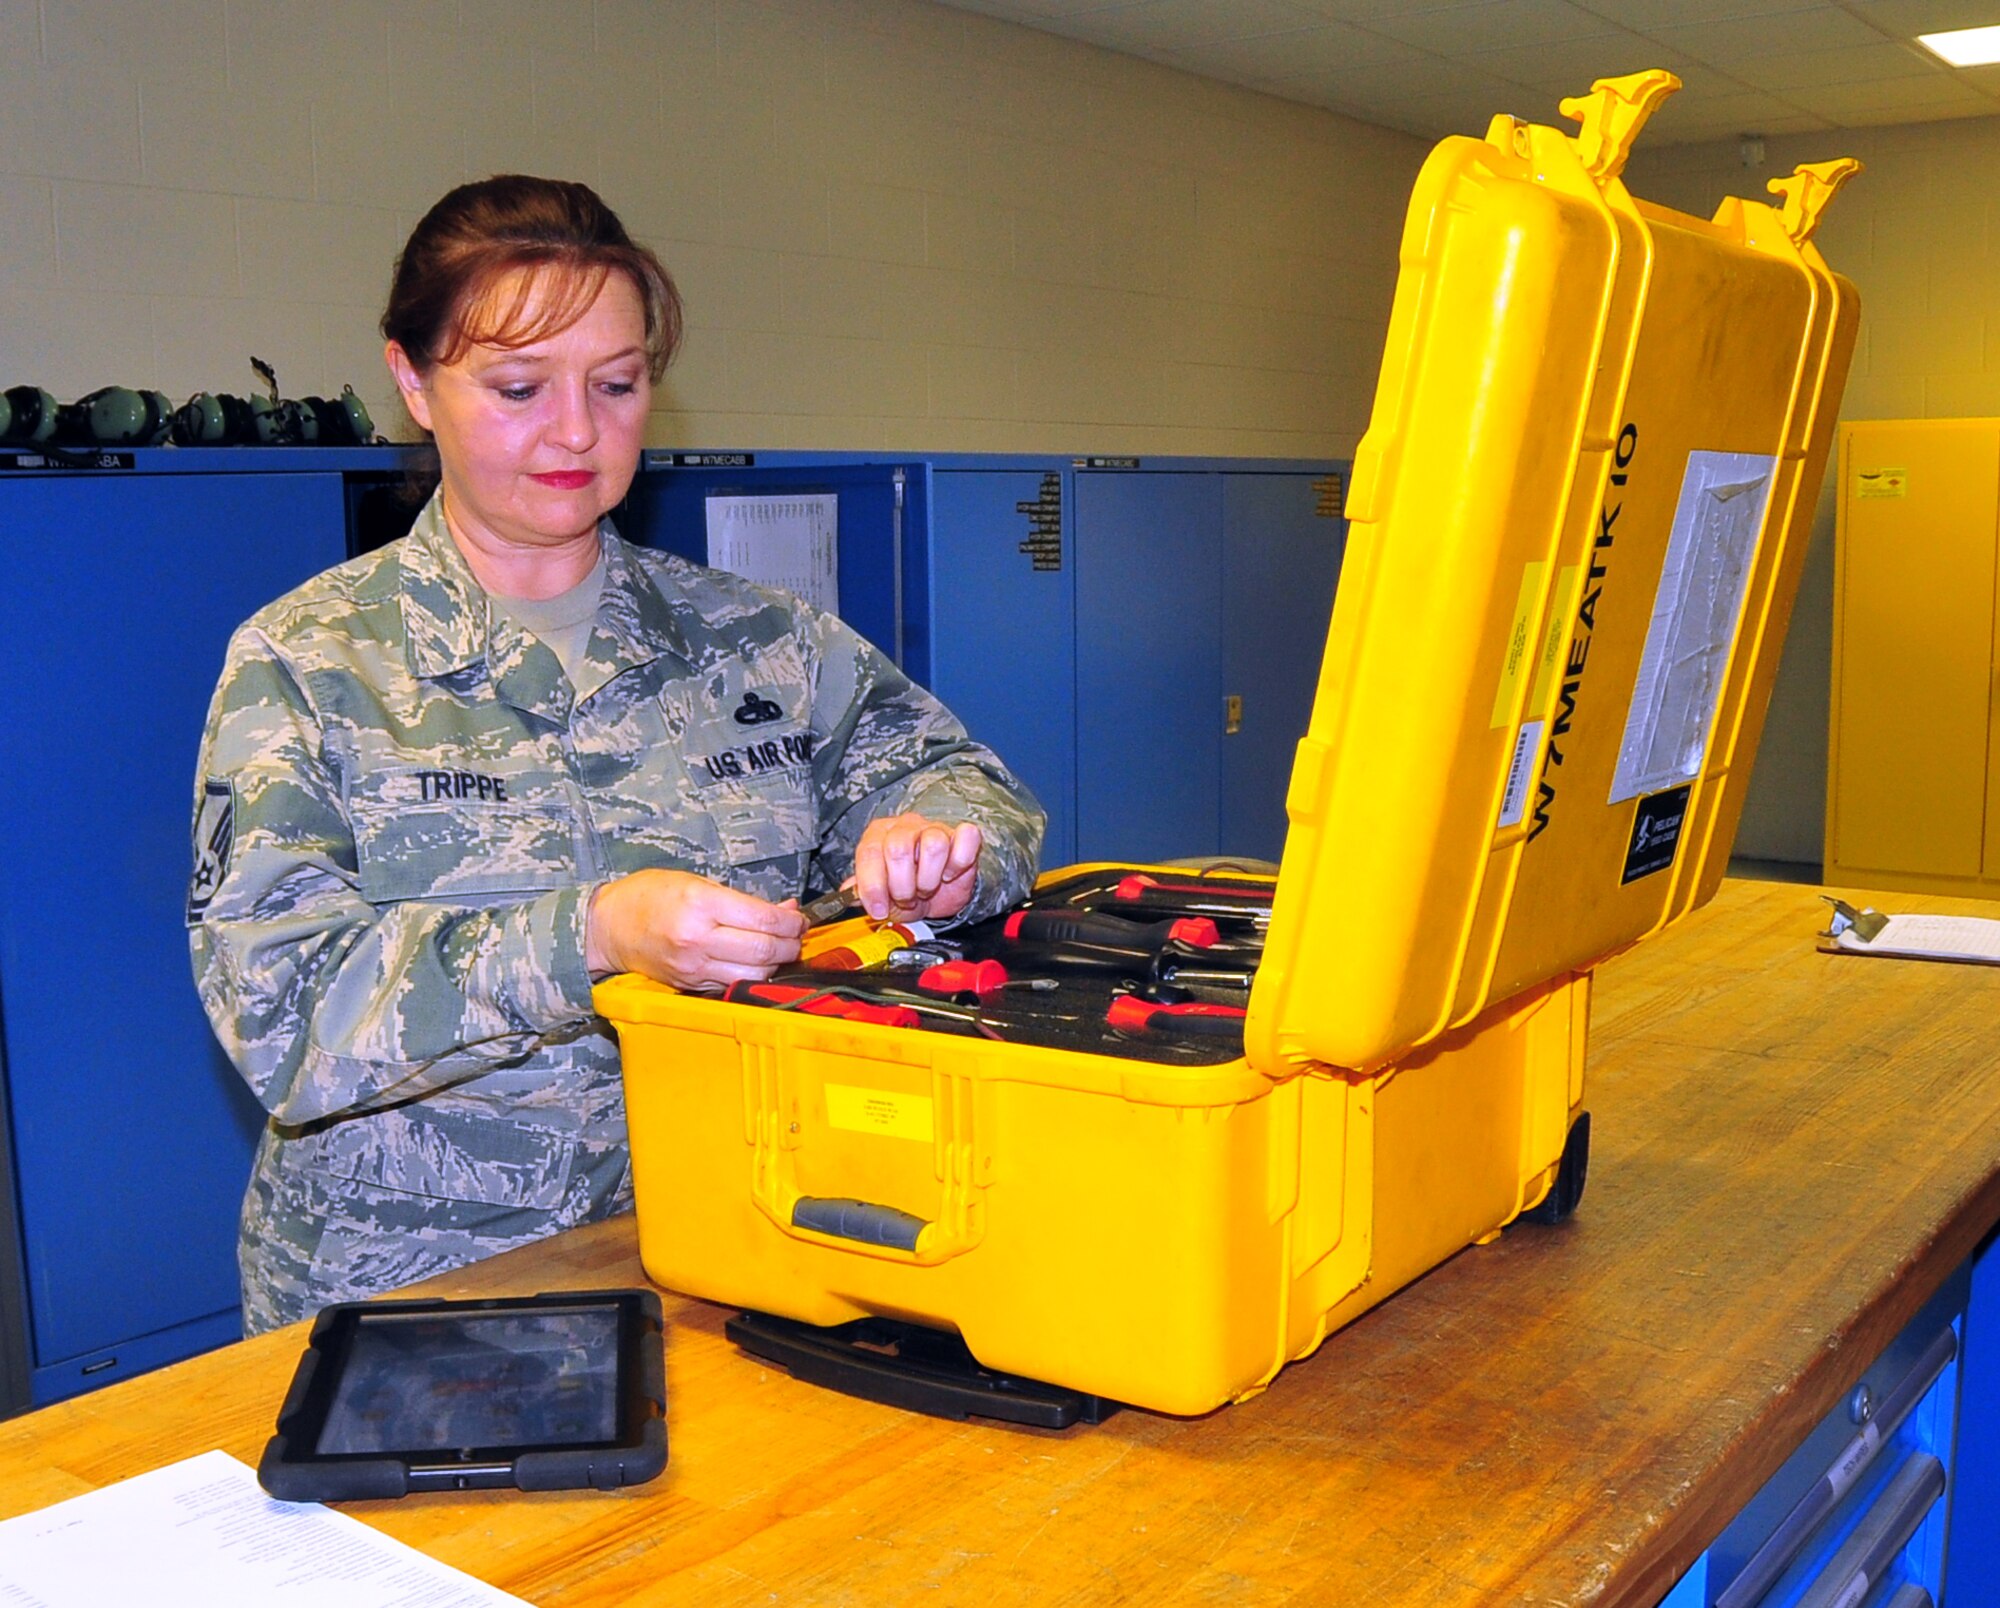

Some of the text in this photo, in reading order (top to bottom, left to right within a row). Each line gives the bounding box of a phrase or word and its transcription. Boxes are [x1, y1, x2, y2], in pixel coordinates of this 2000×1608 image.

[1526, 422, 1638, 844] W7MEATK 10
[704, 752, 745, 780] US
[746, 741, 788, 771] AIR
[415, 771, 508, 802] TRIPPE
